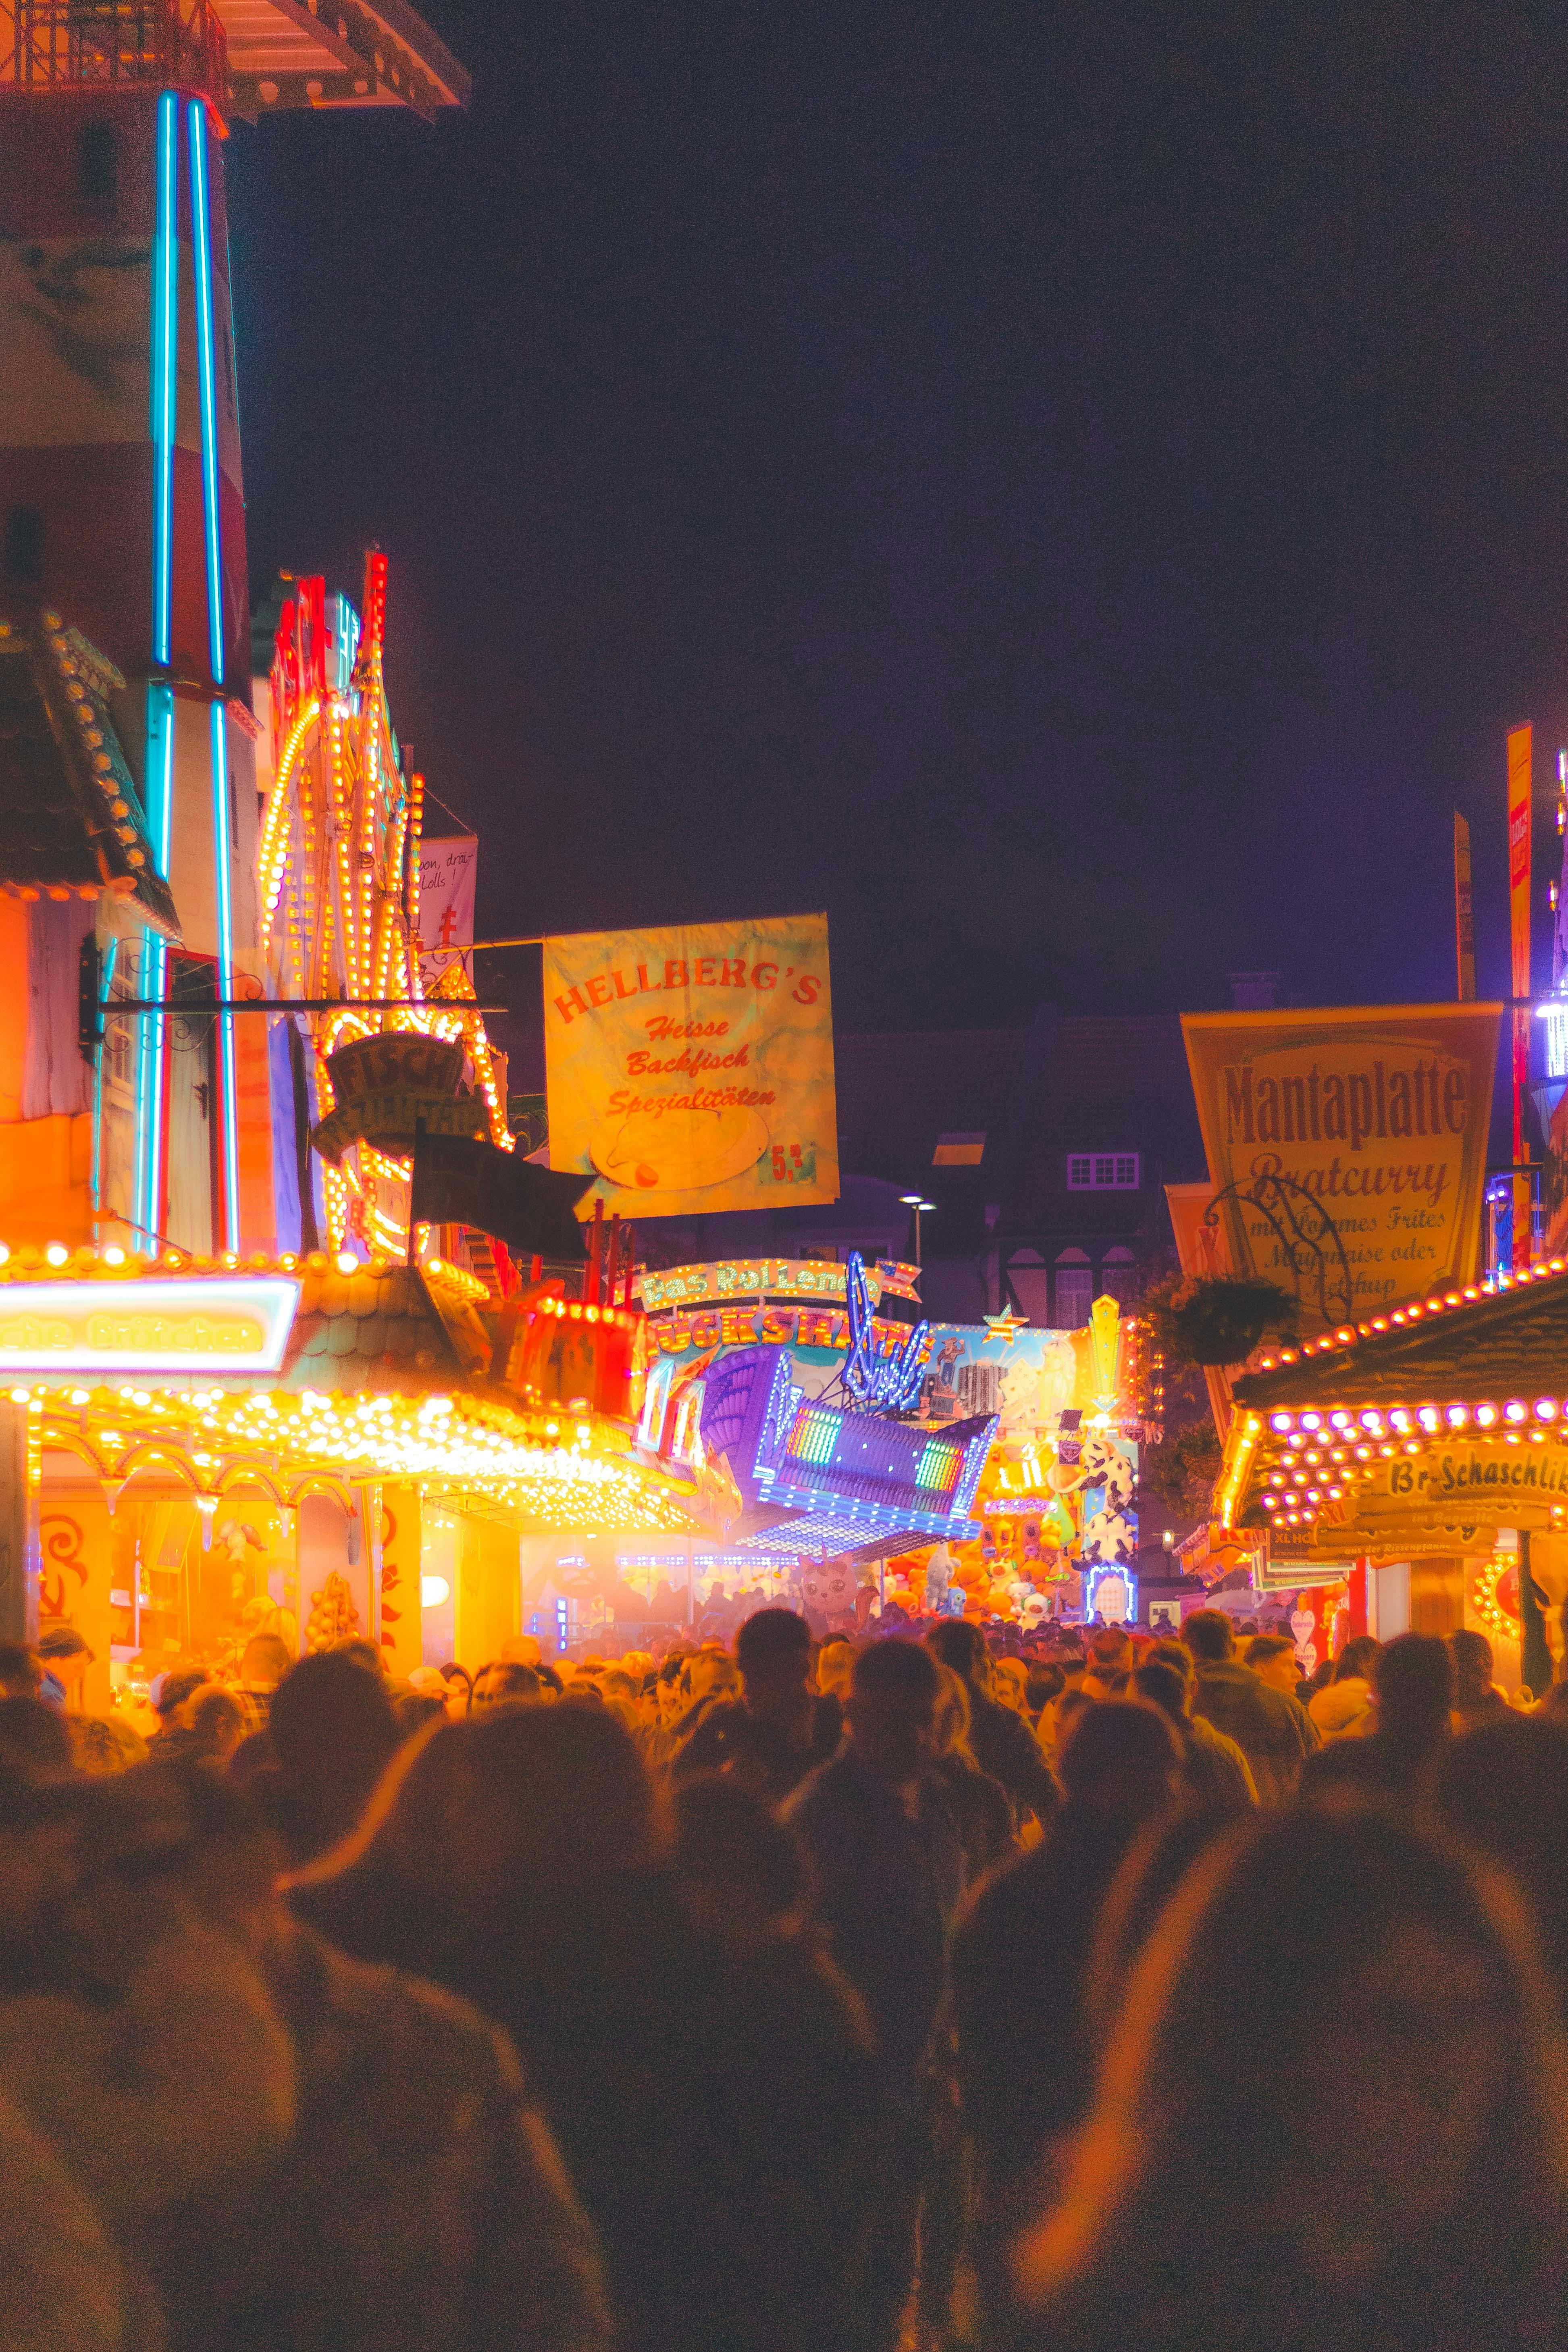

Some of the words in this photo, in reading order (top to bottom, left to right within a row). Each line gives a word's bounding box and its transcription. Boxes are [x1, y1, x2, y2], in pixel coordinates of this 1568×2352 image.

[421, 871, 446, 890] Lolls
[554, 957, 821, 1024] HELLBERG'S
[645, 1015, 729, 1042] Heisse
[336, 1044, 457, 1095] FISCH
[626, 1044, 750, 1077] Backfisch
[606, 1086, 776, 1118] Spezialitäten
[1224, 1058, 1465, 1151] Mantaplatte
[1246, 1152, 1448, 1208] Bratcurry
[1387, 1206, 1445, 1229] Frites
[1391, 1237, 1436, 1261] oder
[643, 1273, 709, 1303] Das
[1365, 1545, 1381, 1553] der
